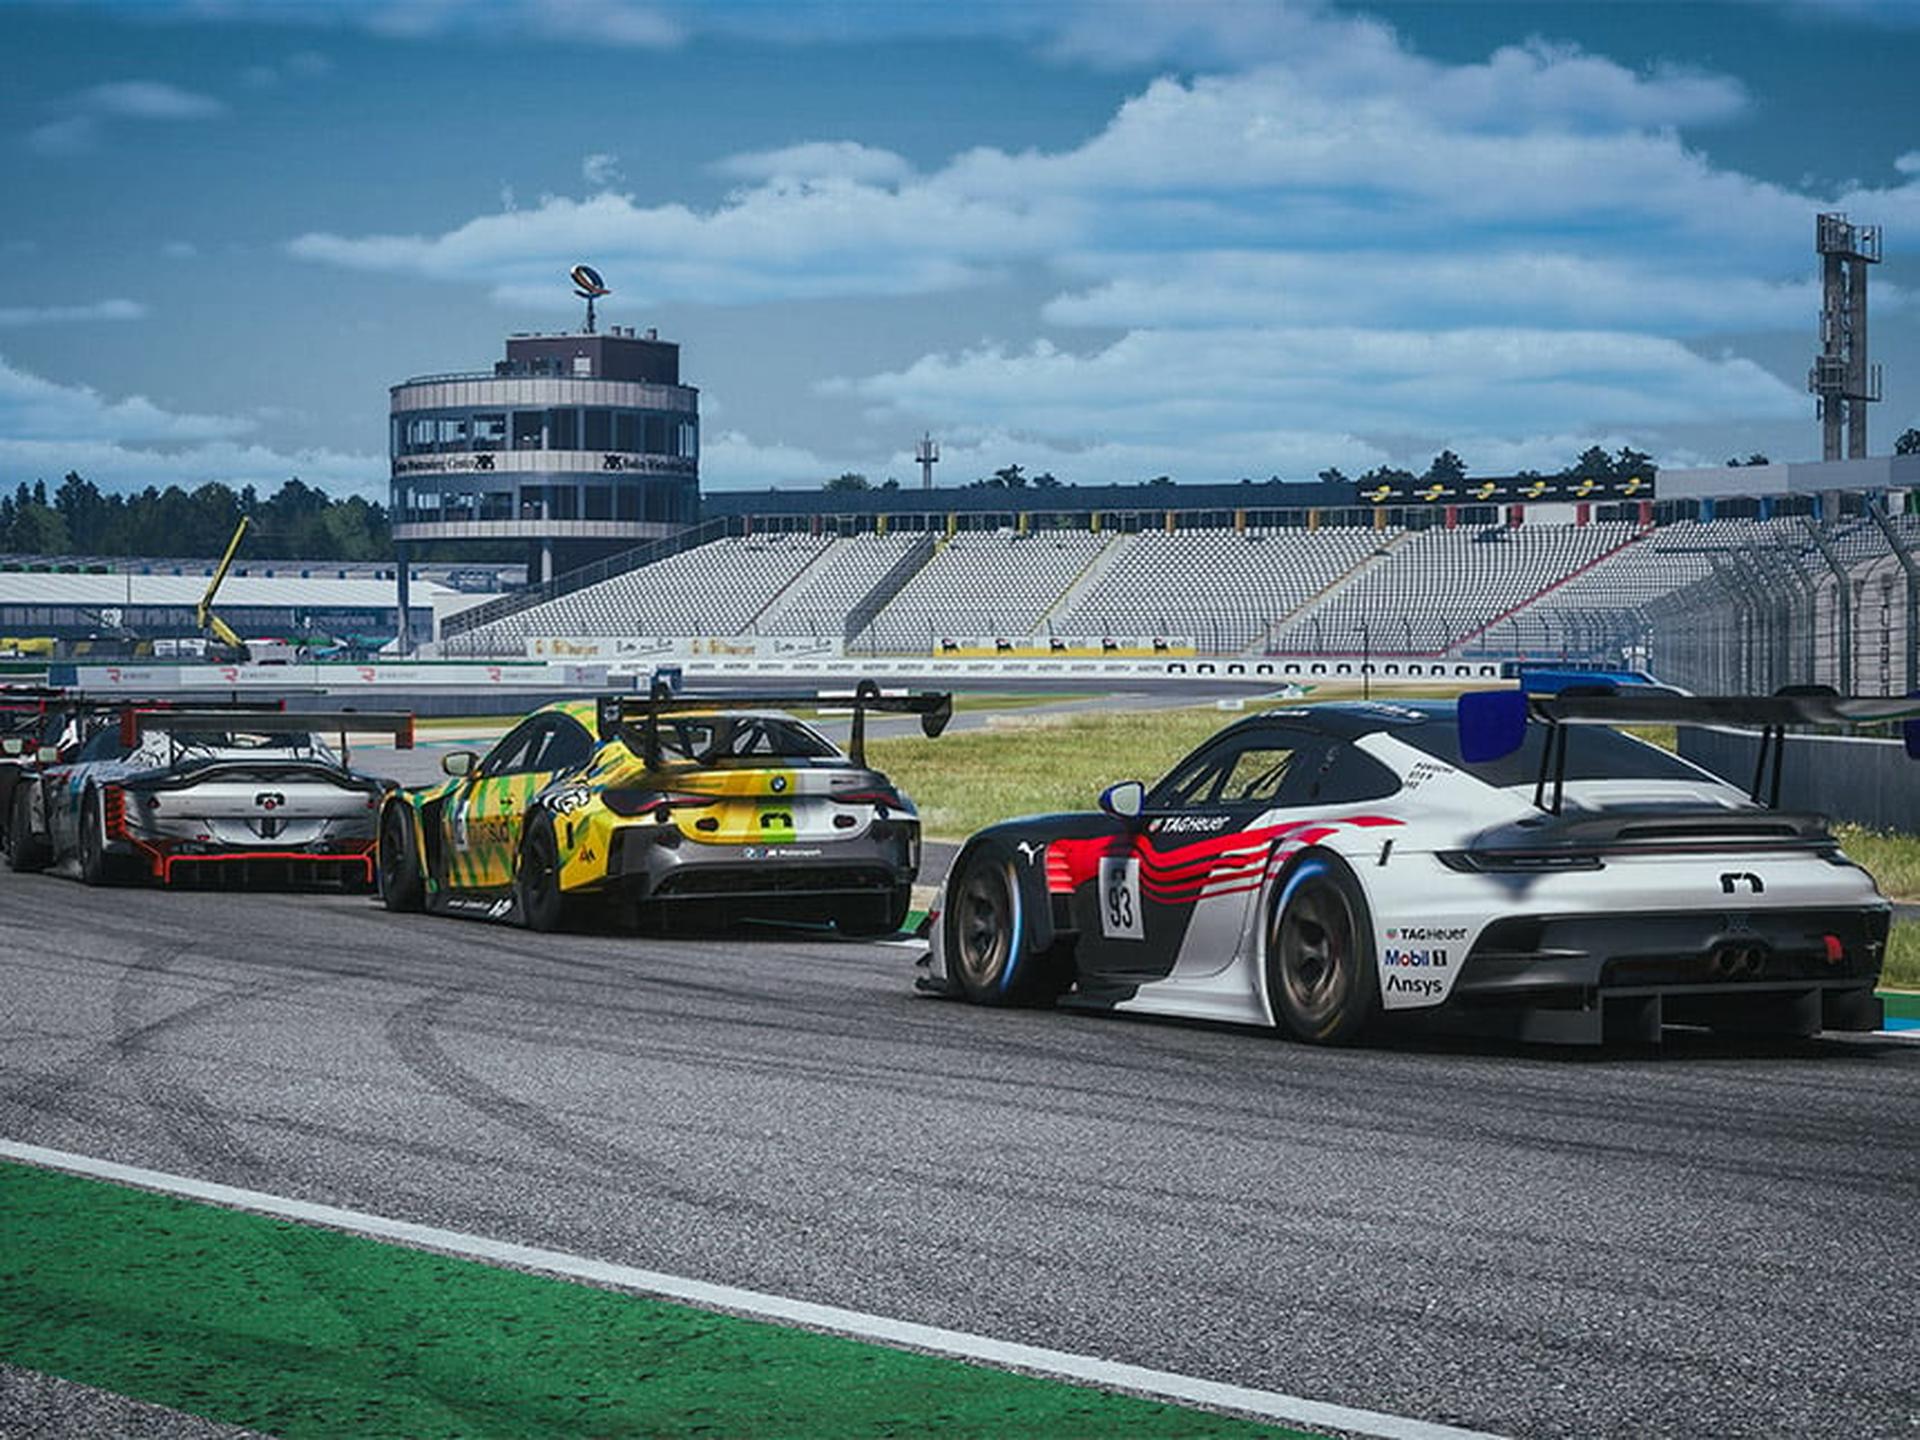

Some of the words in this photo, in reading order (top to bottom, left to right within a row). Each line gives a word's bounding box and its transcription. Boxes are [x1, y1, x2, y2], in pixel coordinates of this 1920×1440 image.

[1108, 887, 1133, 929] 93
[1385, 949, 1430, 967] Mobil
[1387, 974, 1443, 997] Ansys
